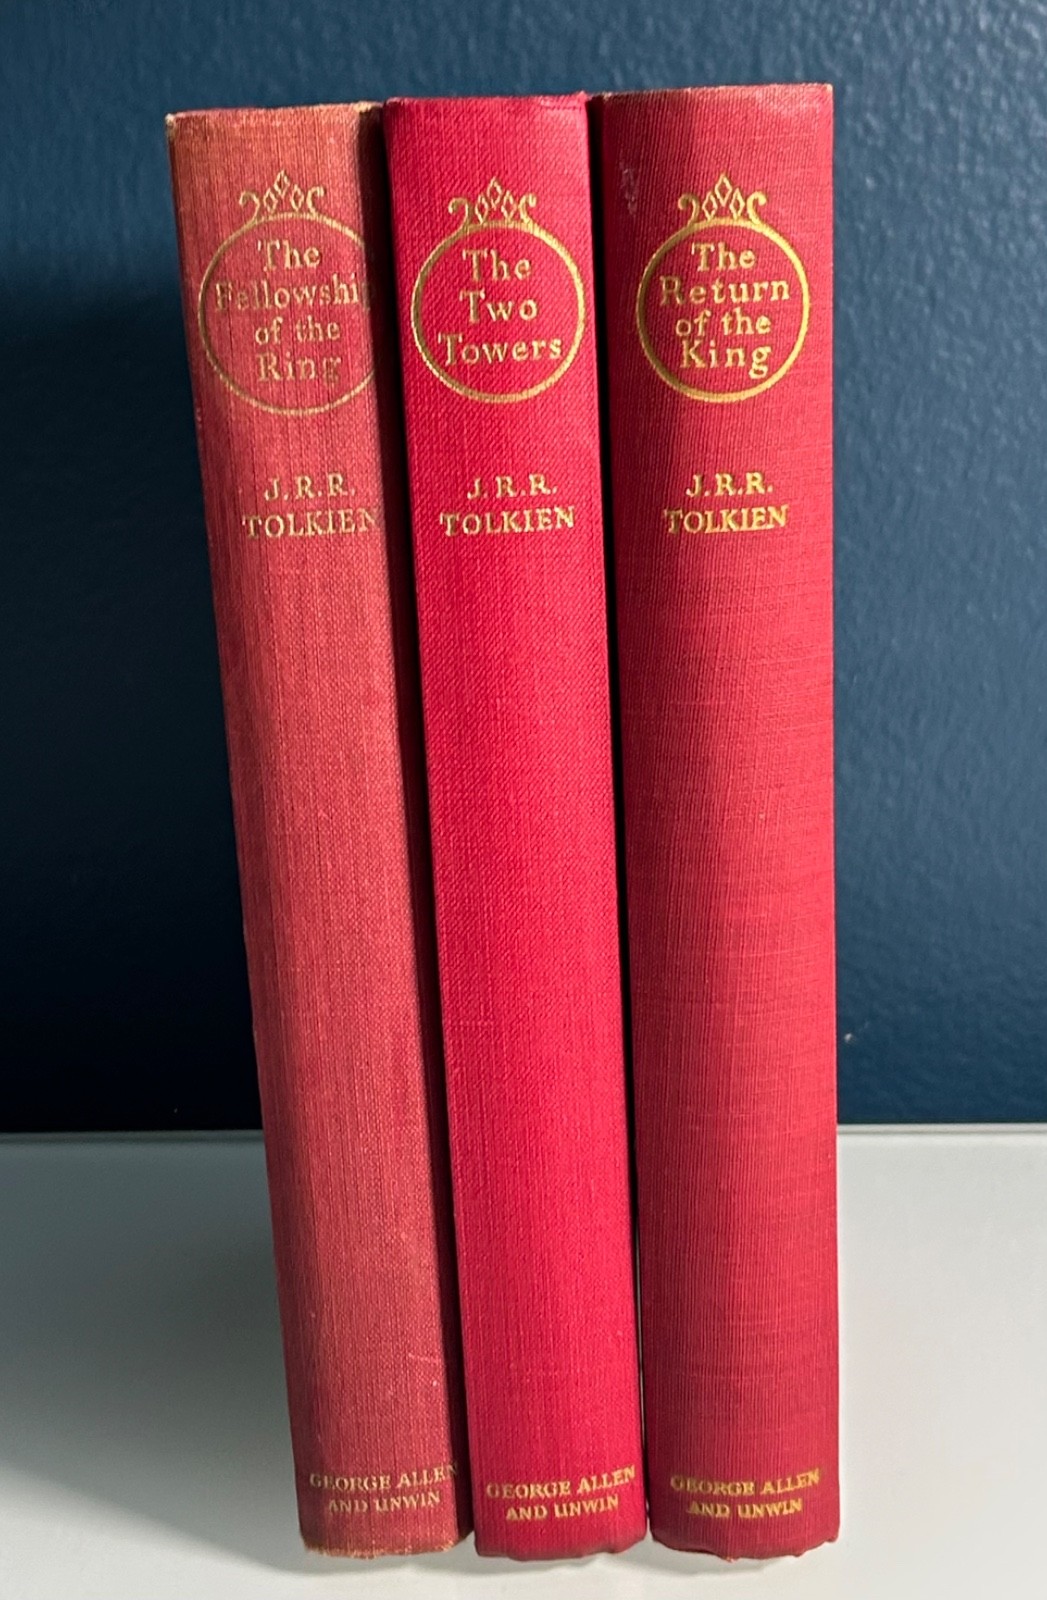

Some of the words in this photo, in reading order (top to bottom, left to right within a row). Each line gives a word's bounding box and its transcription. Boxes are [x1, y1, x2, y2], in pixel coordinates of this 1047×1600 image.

[258, 240, 321, 272] The
[463, 249, 531, 281] The
[691, 242, 756, 272] The
[660, 276, 790, 305] Return
[459, 290, 538, 323] Two
[255, 316, 282, 345] of
[296, 315, 340, 341] the
[676, 310, 712, 337] of
[722, 308, 771, 335] the
[438, 333, 562, 365] Towers
[680, 339, 772, 379] King
[258, 352, 341, 383] Ring
[686, 472, 773, 497] J.R.R.
[242, 508, 379, 539] TOLKIEN
[440, 506, 575, 536] TOLKIEN
[663, 505, 789, 534] TOLKIEN
[310, 1473, 391, 1492] GEORGE
[397, 1465, 458, 1486] ALLEN
[486, 1480, 571, 1498] GEORGE
[577, 1466, 636, 1493] ALLEN
[671, 1475, 755, 1495] GEORGE
[761, 1469, 821, 1494] ALLEN
[329, 1497, 369, 1513] AND
[375, 1491, 440, 1511] UNWIN
[506, 1505, 548, 1520] AND
[554, 1496, 619, 1517] UNWIN
[687, 1500, 730, 1518] AND
[738, 1498, 803, 1518] UNWIN
